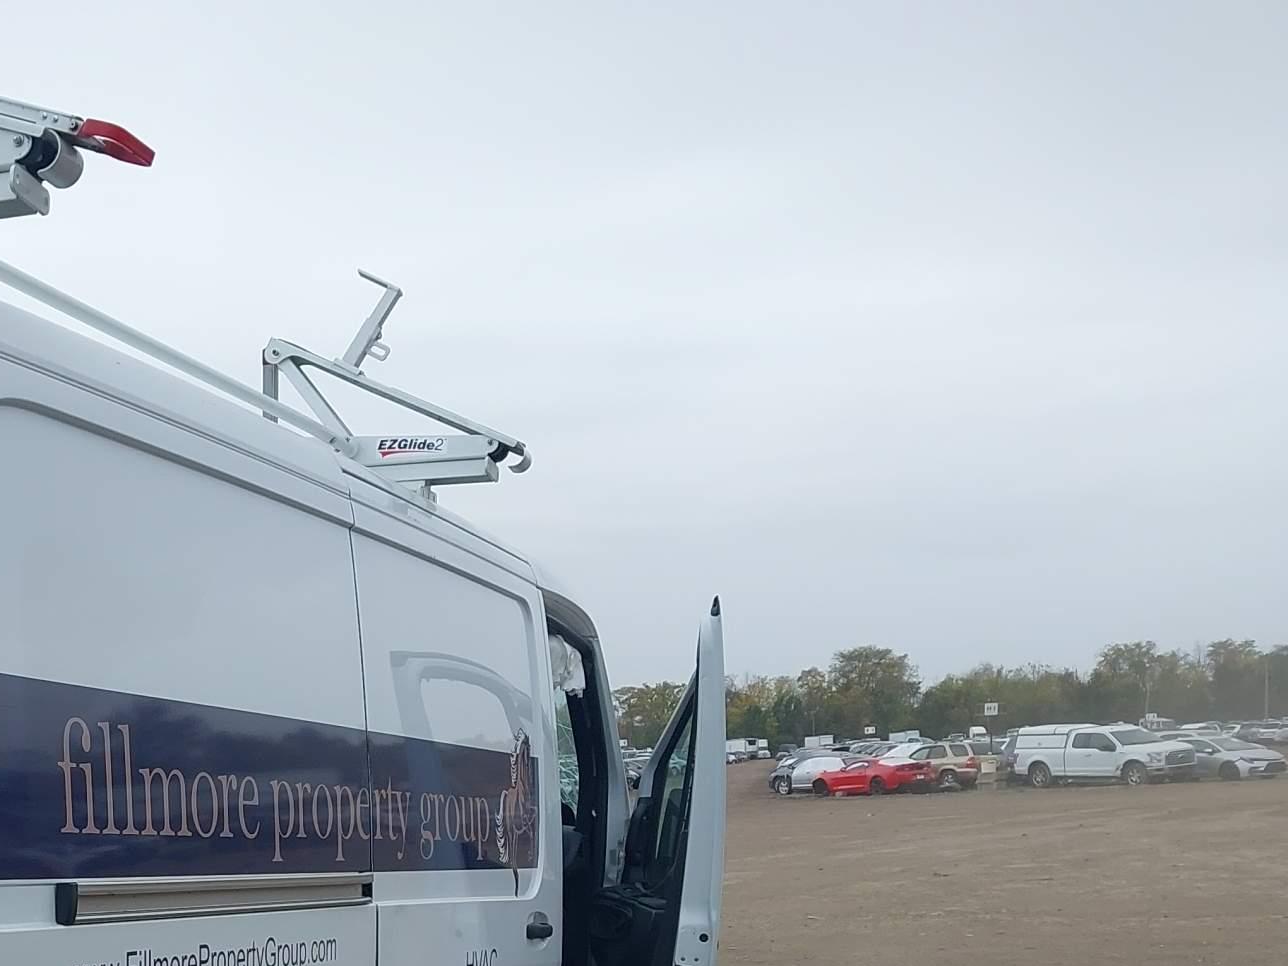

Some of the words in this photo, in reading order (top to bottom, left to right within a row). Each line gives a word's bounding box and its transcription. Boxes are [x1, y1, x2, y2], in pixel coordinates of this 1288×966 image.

[57, 716, 260, 840] fillmore
[270, 777, 411, 862] property
[419, 790, 490, 861] group
